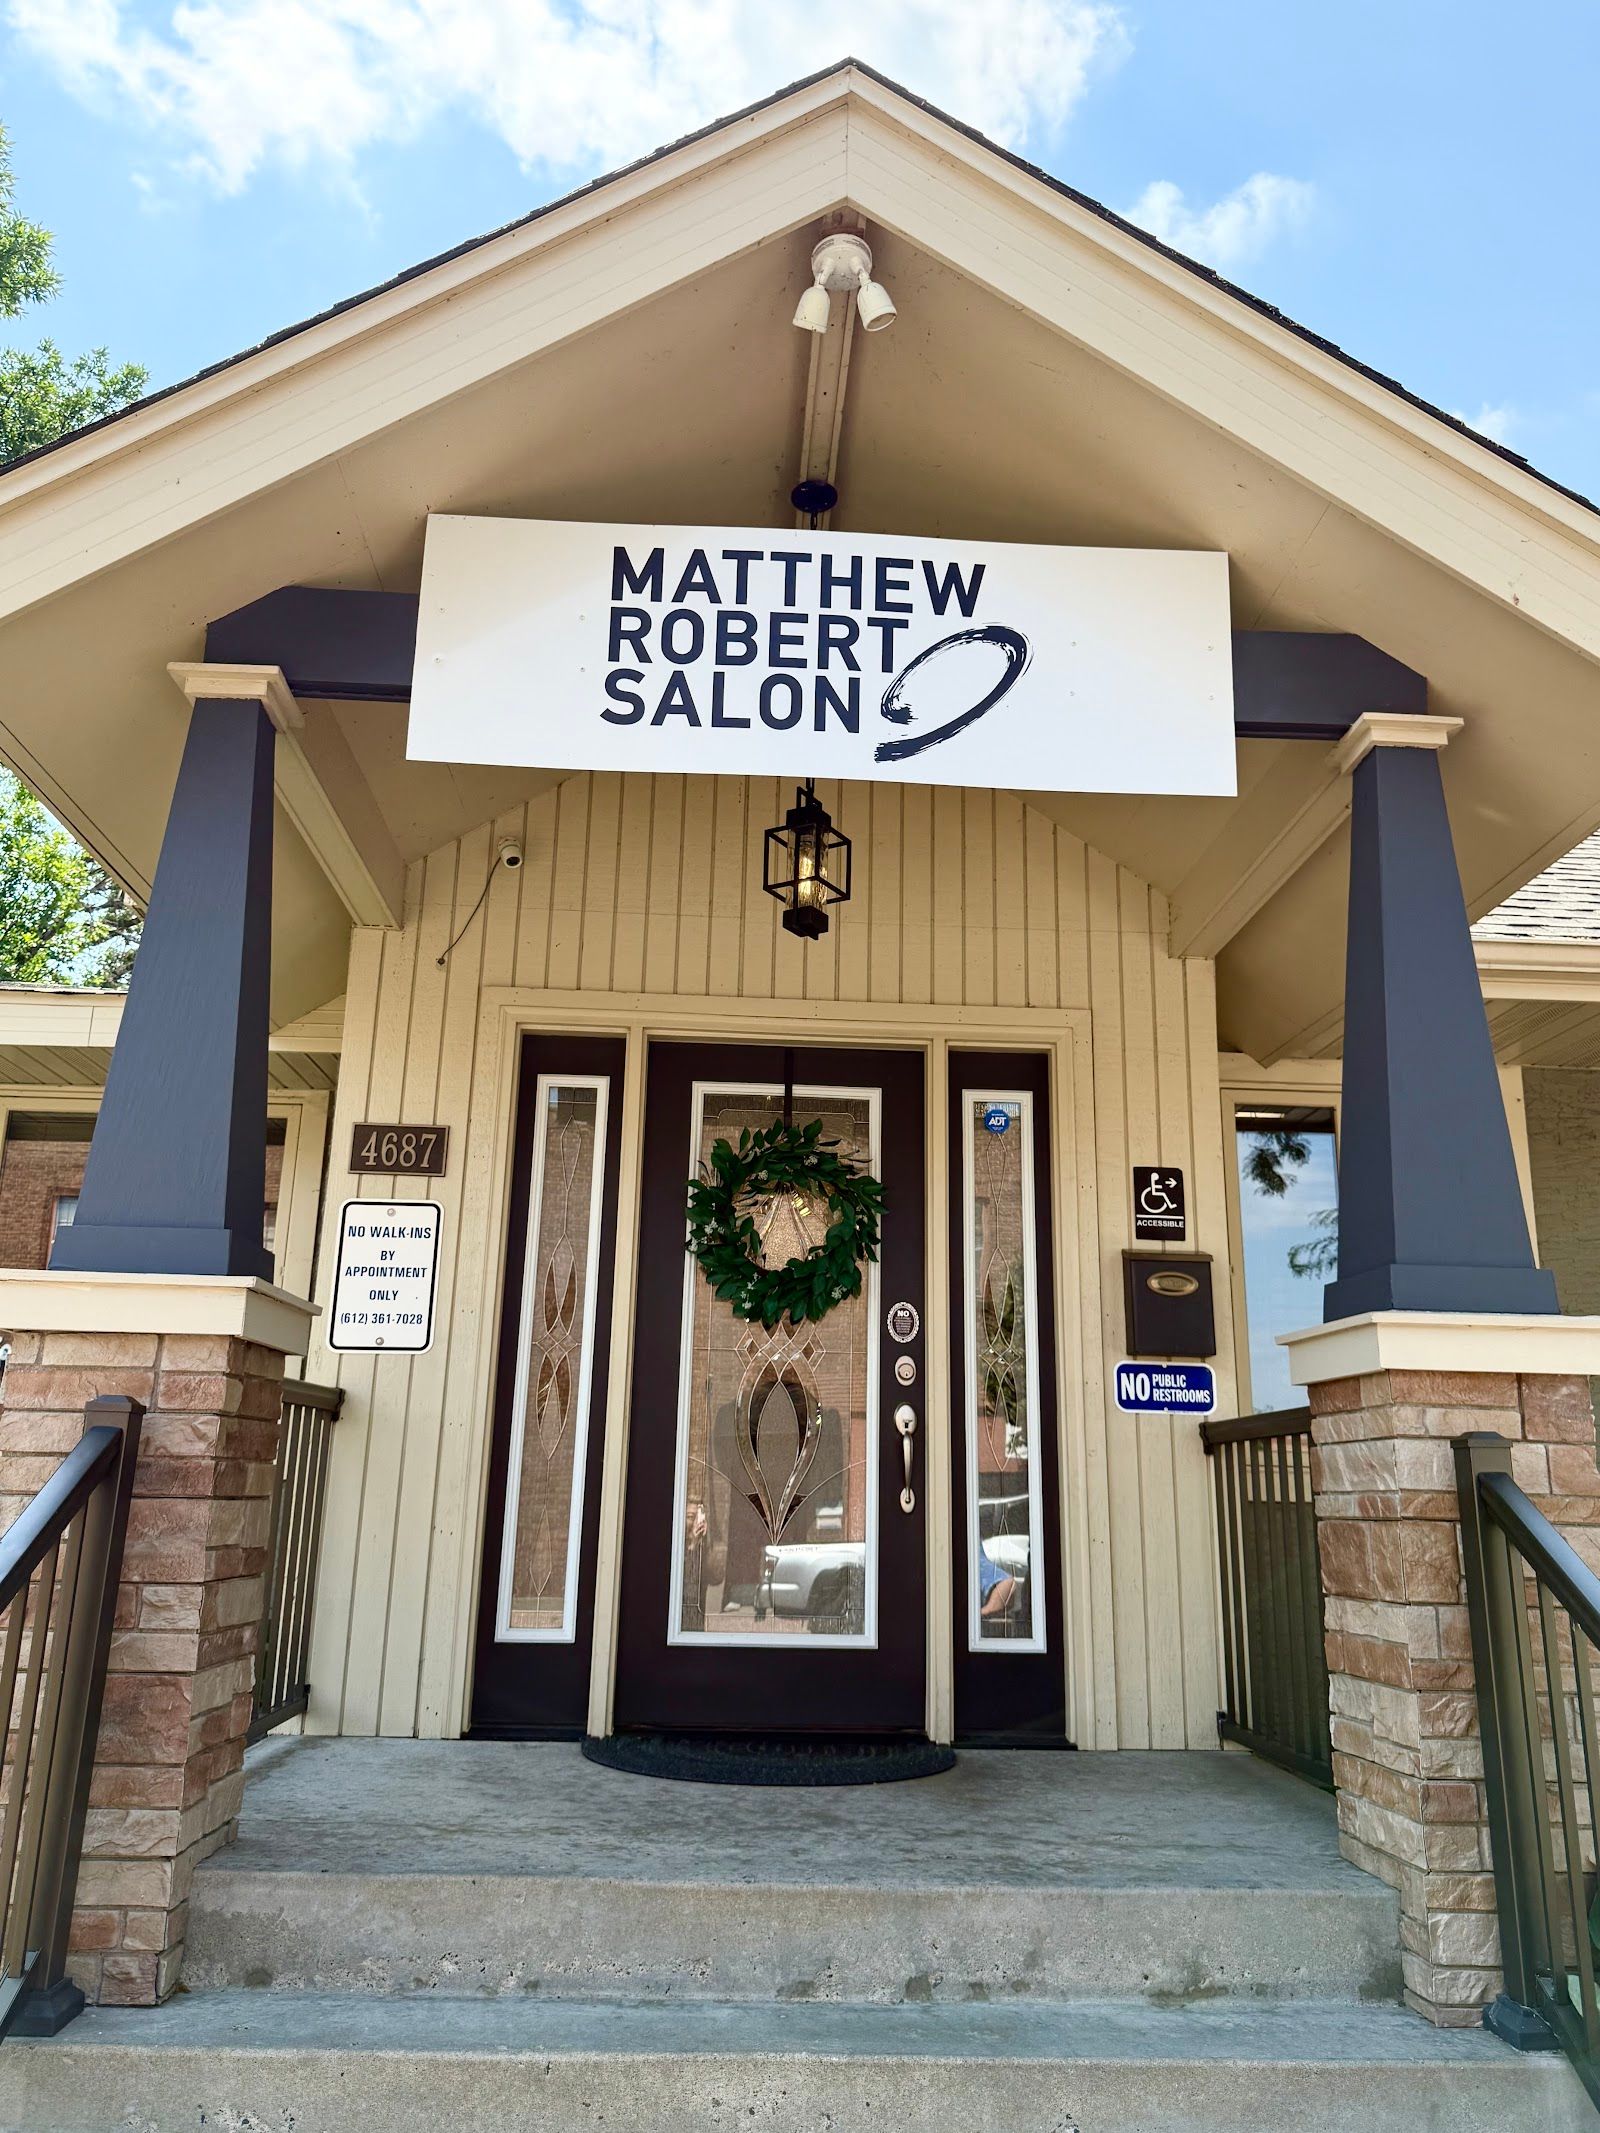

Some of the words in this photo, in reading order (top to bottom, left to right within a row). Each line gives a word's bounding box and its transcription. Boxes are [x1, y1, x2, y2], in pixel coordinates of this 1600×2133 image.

[611, 546, 986, 617] MATTHEW
[608, 607, 909, 673] ROBERT
[600, 668, 860, 733] SALON
[988, 1116, 1007, 1127] ADT
[360, 1131, 437, 1168] 4687
[1136, 1219, 1185, 1228] ACCESSIBLE
[348, 1225, 366, 1238] NO
[370, 1226, 432, 1239] WALK-INS
[380, 1250, 396, 1261] BY
[344, 1266, 428, 1278] APPOINTMENT
[369, 1289, 399, 1301] ONLY
[340, 1312, 368, 1325] (612)
[371, 1313, 423, 1325] 361-7028
[1120, 1372, 1151, 1402] NO
[1151, 1373, 1187, 1388] PUBLIC
[1152, 1388, 1211, 1403] RESTROOMS
